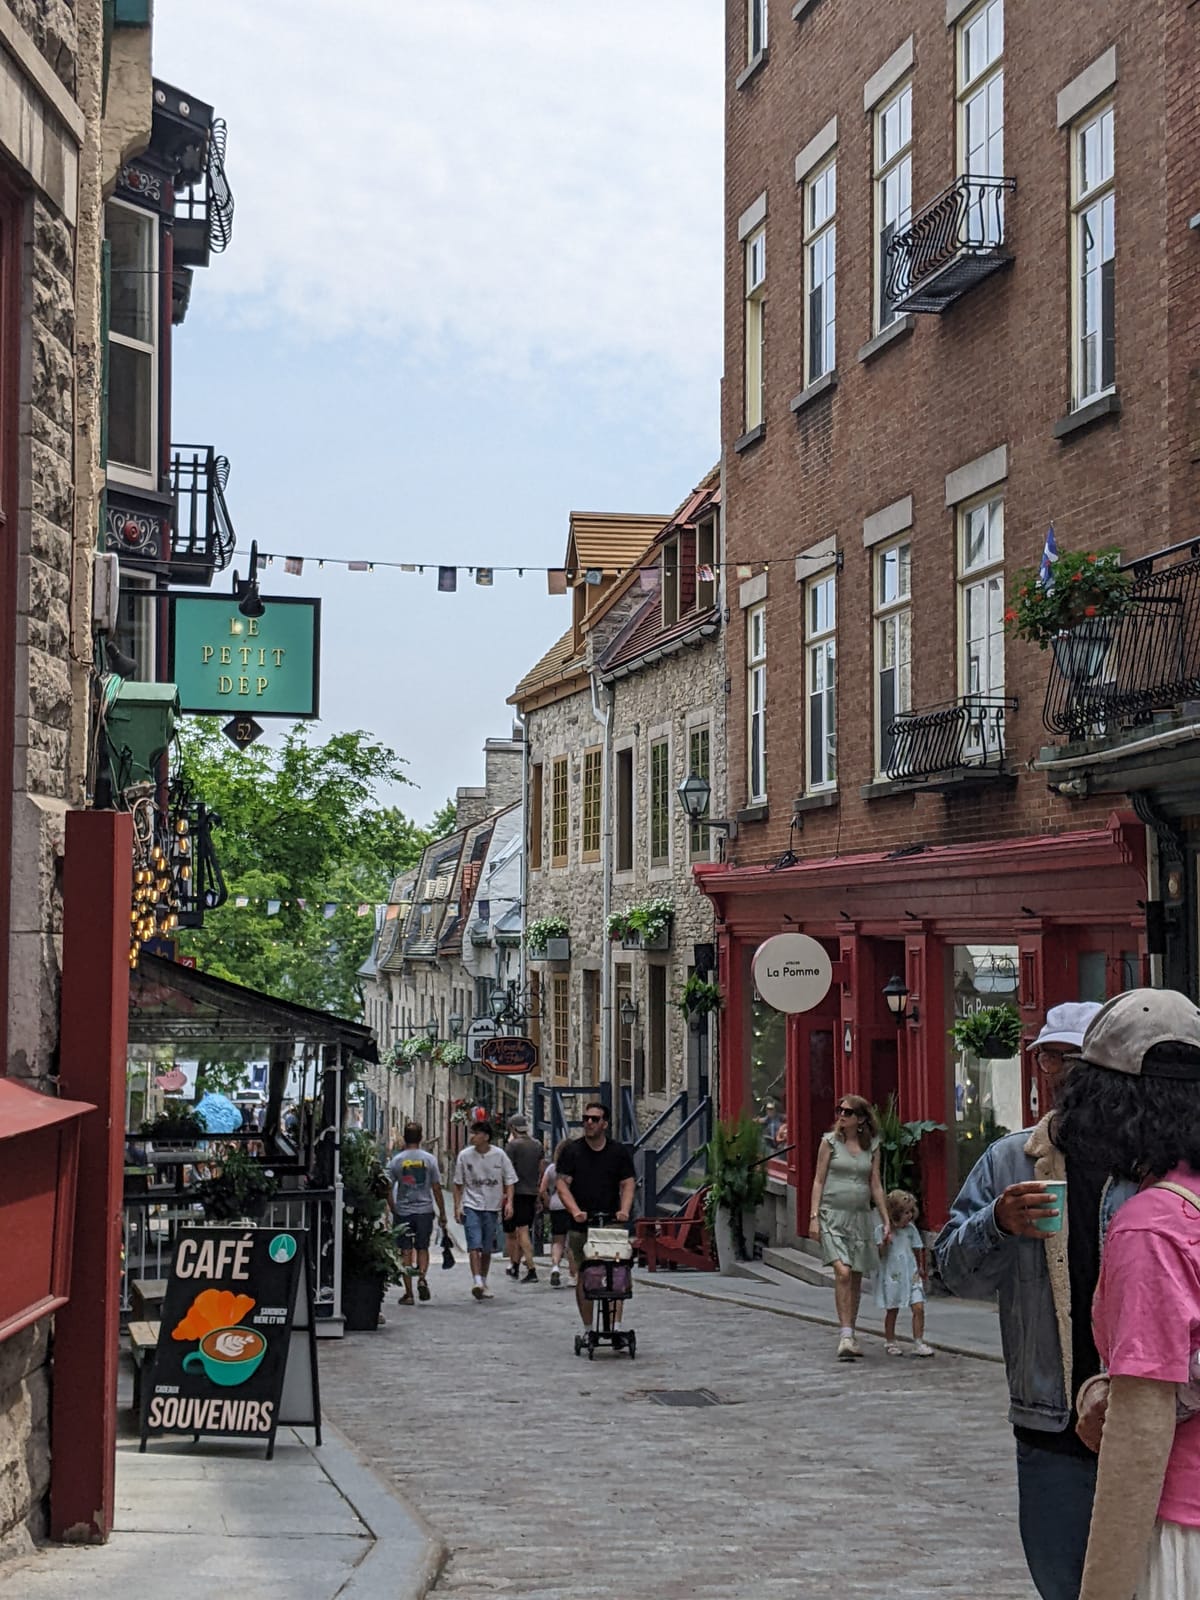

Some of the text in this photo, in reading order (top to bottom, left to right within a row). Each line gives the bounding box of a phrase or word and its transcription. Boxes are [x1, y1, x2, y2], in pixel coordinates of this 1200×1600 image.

[230, 617, 260, 635] LE
[202, 646, 285, 667] PETIT
[219, 676, 268, 695] DEP
[236, 723, 251, 741] 52
[767, 966, 819, 977] La Pomme
[175, 1233, 253, 1280] CAFÉ
[148, 1397, 273, 1432] SOUVENIRS
